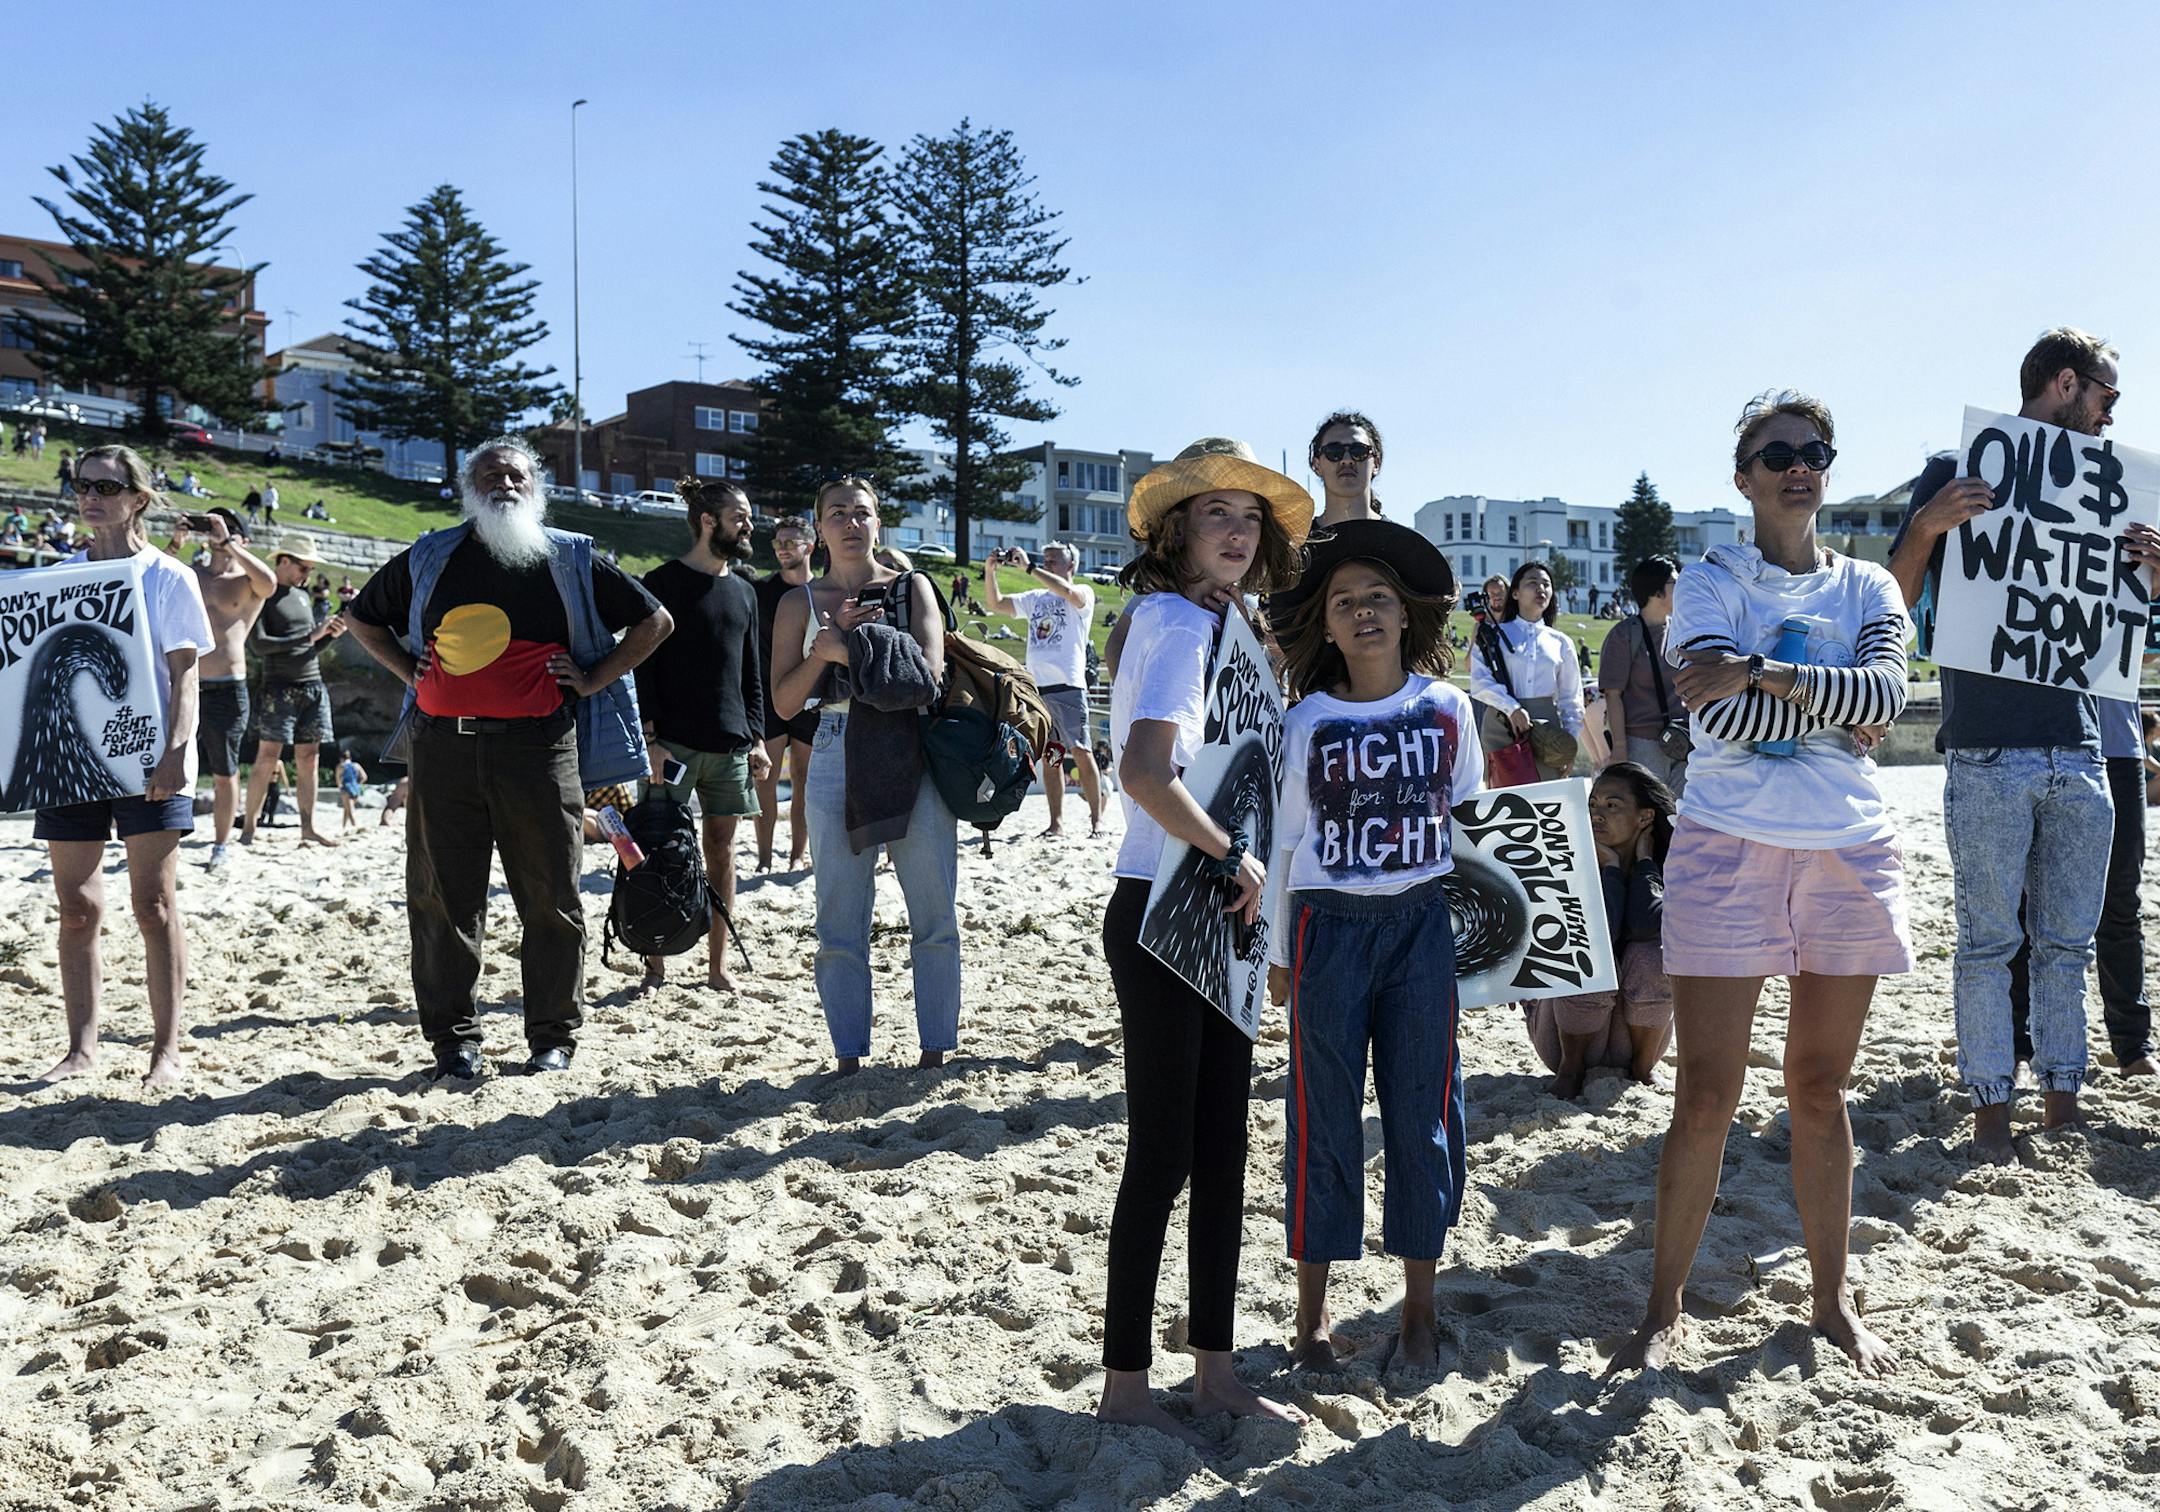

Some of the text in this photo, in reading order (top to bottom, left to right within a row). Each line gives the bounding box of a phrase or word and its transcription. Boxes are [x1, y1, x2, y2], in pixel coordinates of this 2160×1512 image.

[1967, 427, 2076, 523] OIL
[1958, 516, 2149, 604] WATER
[0, 591, 41, 614] ON'T
[2006, 584, 2147, 678] DON'T
[0, 594, 66, 672] POIL
[1990, 625, 2090, 689] MIX
[1229, 639, 1260, 691] DON'T
[103, 715, 152, 734] FIGHT
[1204, 666, 1265, 745] SPOIL
[101, 726, 157, 746] FOR THE
[106, 738, 157, 758] BIGHT
[1320, 728, 1445, 783] FIGHT
[1349, 783, 1427, 817] for the
[1321, 816, 1444, 867] BIGHT
[1451, 793, 1570, 904] SPOIL
[1532, 802, 1575, 872] DON'T
